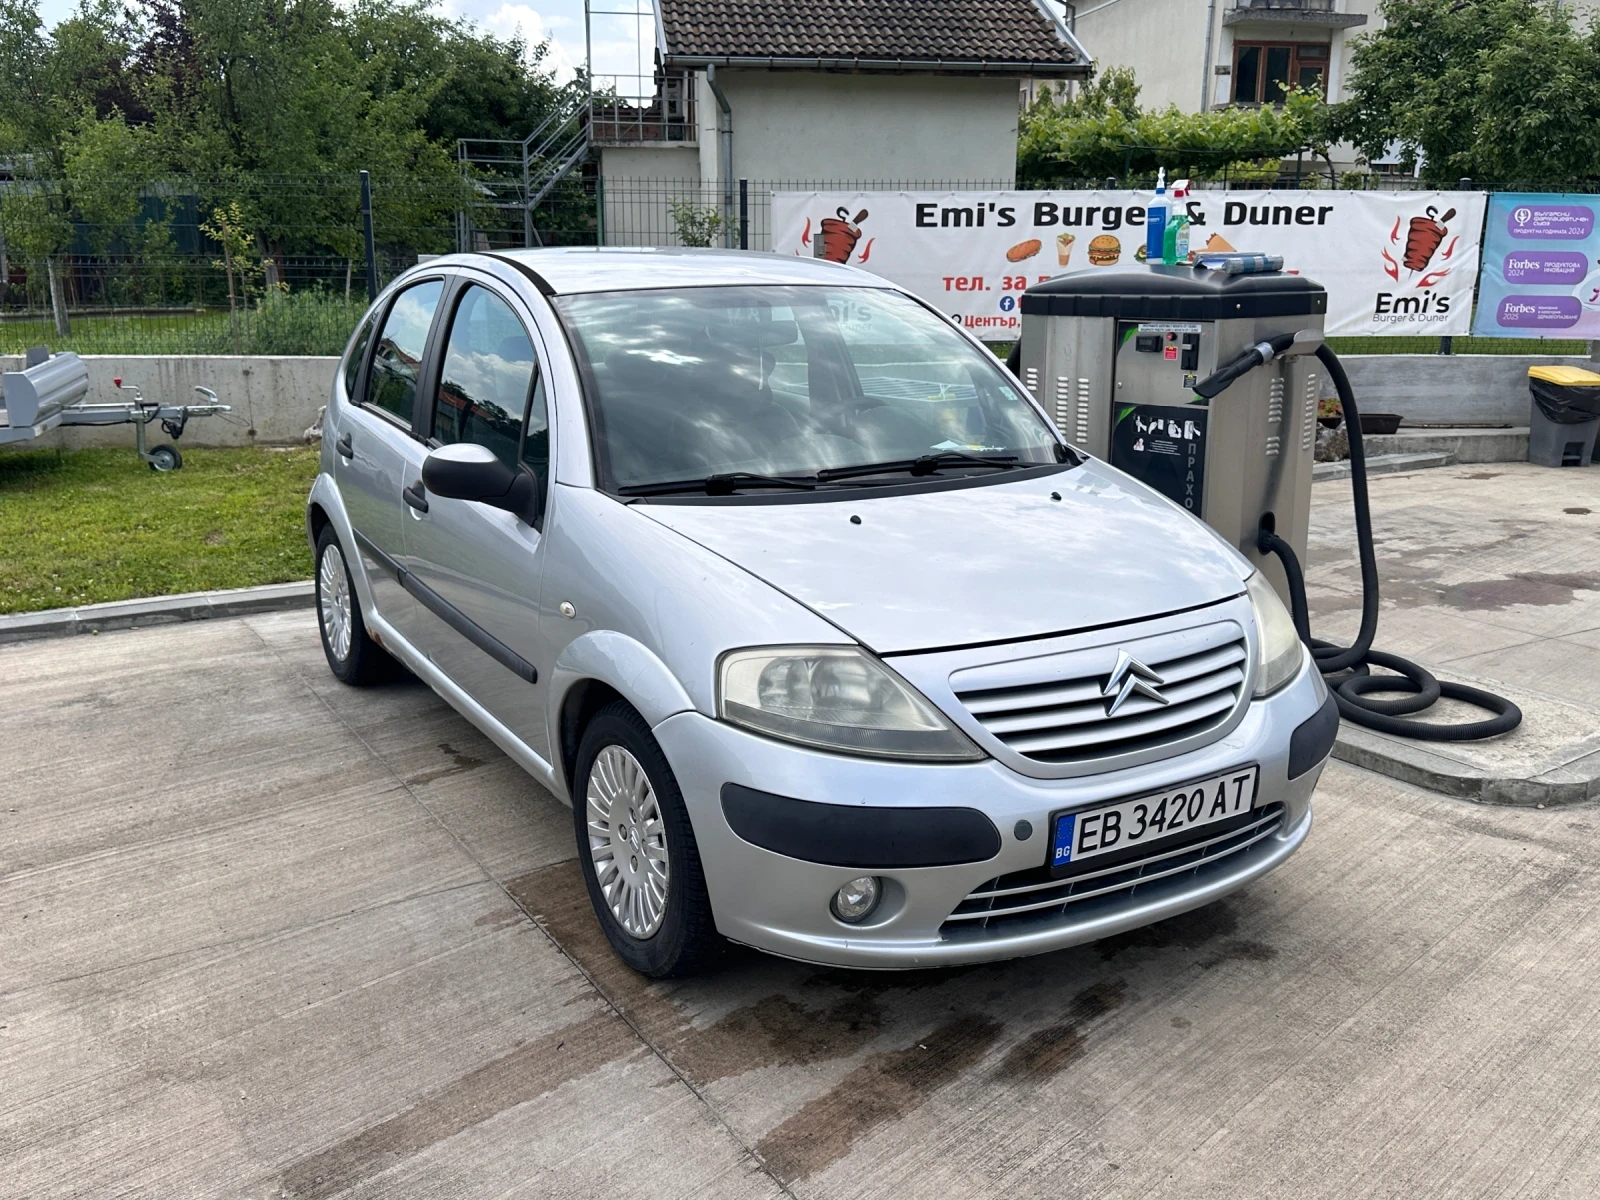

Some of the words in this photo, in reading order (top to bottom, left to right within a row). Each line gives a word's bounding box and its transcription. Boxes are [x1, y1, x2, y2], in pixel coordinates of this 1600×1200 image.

[915, 202, 1016, 228] Emi's
[1033, 202, 1146, 231] Burge
[1185, 201, 1206, 226] &
[1223, 201, 1334, 226] Duner
[1568, 227, 1585, 235] 2024
[1508, 259, 1540, 269] Forbes
[942, 276, 991, 292] тел.
[1001, 275, 1027, 291] за
[1374, 290, 1451, 314] Emi's
[1505, 303, 1535, 313] Forbes
[964, 315, 1021, 328] Център,
[1372, 313, 1407, 324] Burger
[1408, 313, 1416, 322] &
[1418, 313, 1449, 322] Duner
[1184, 443, 1197, 509] ПРАХО
[1077, 809, 1122, 854] EB
[1127, 788, 1205, 841] 3420
[1208, 773, 1251, 818] AT
[1055, 845, 1071, 859] BG
